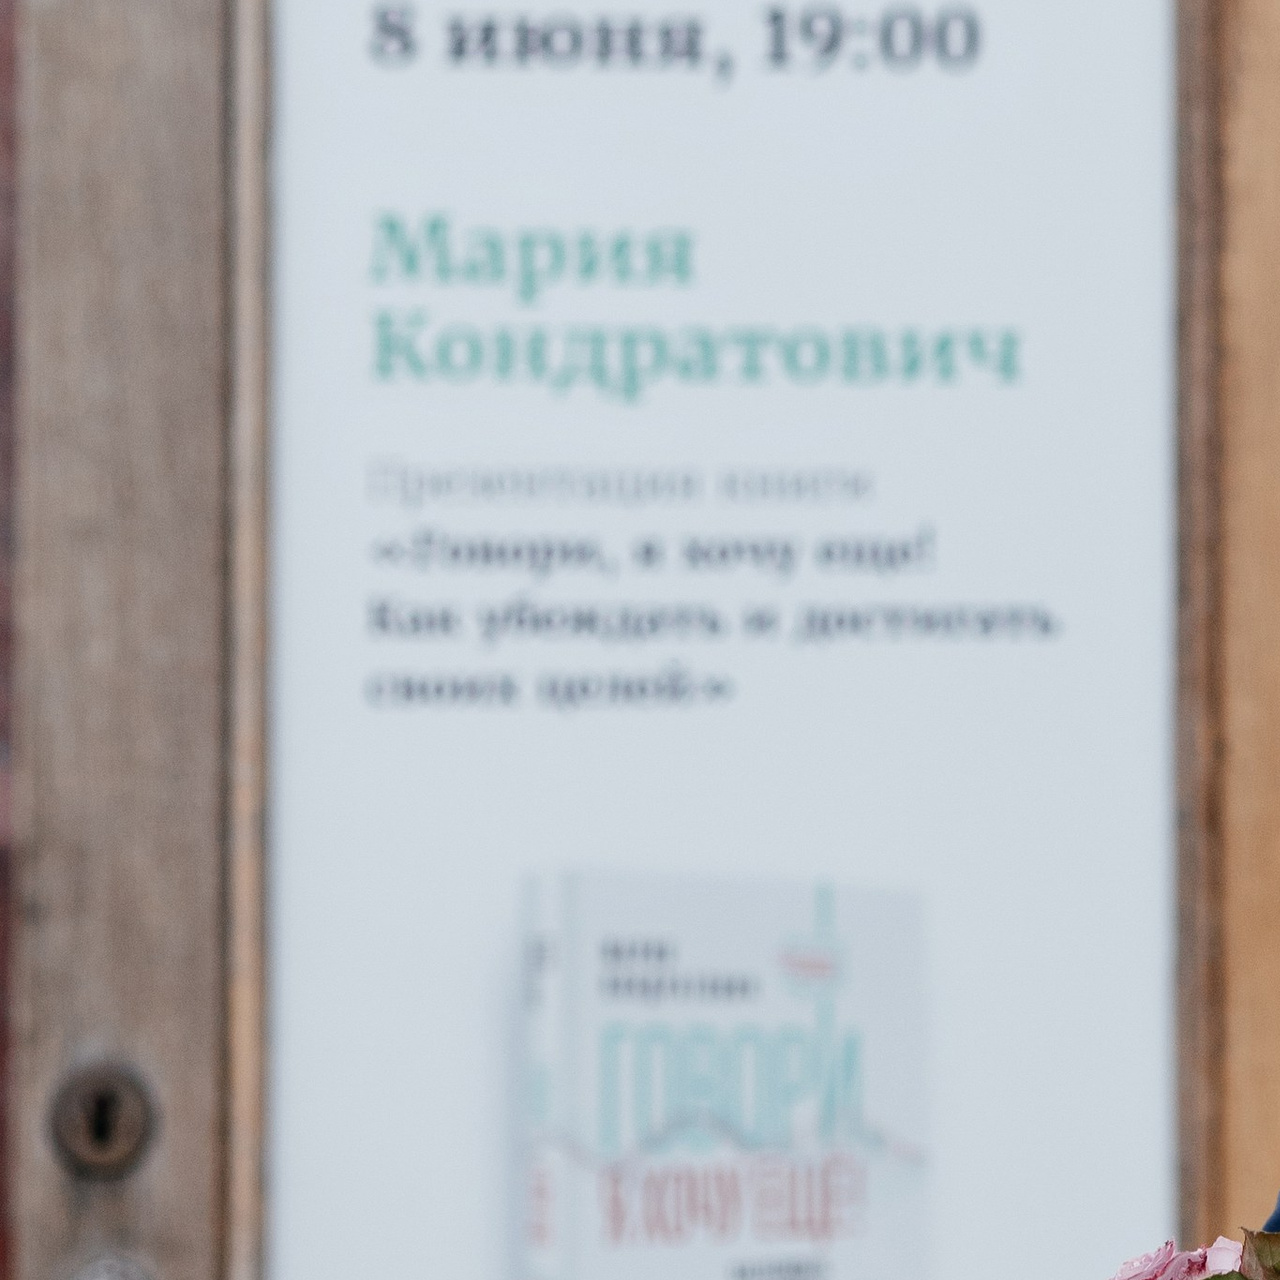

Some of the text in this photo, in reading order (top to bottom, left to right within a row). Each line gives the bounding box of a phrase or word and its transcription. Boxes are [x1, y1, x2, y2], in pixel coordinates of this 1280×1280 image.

[447, 12, 737, 85] июня,
[764, 1, 983, 73] 19:00
[371, 213, 695, 307] Мария
[371, 308, 1020, 404] Кондратович
